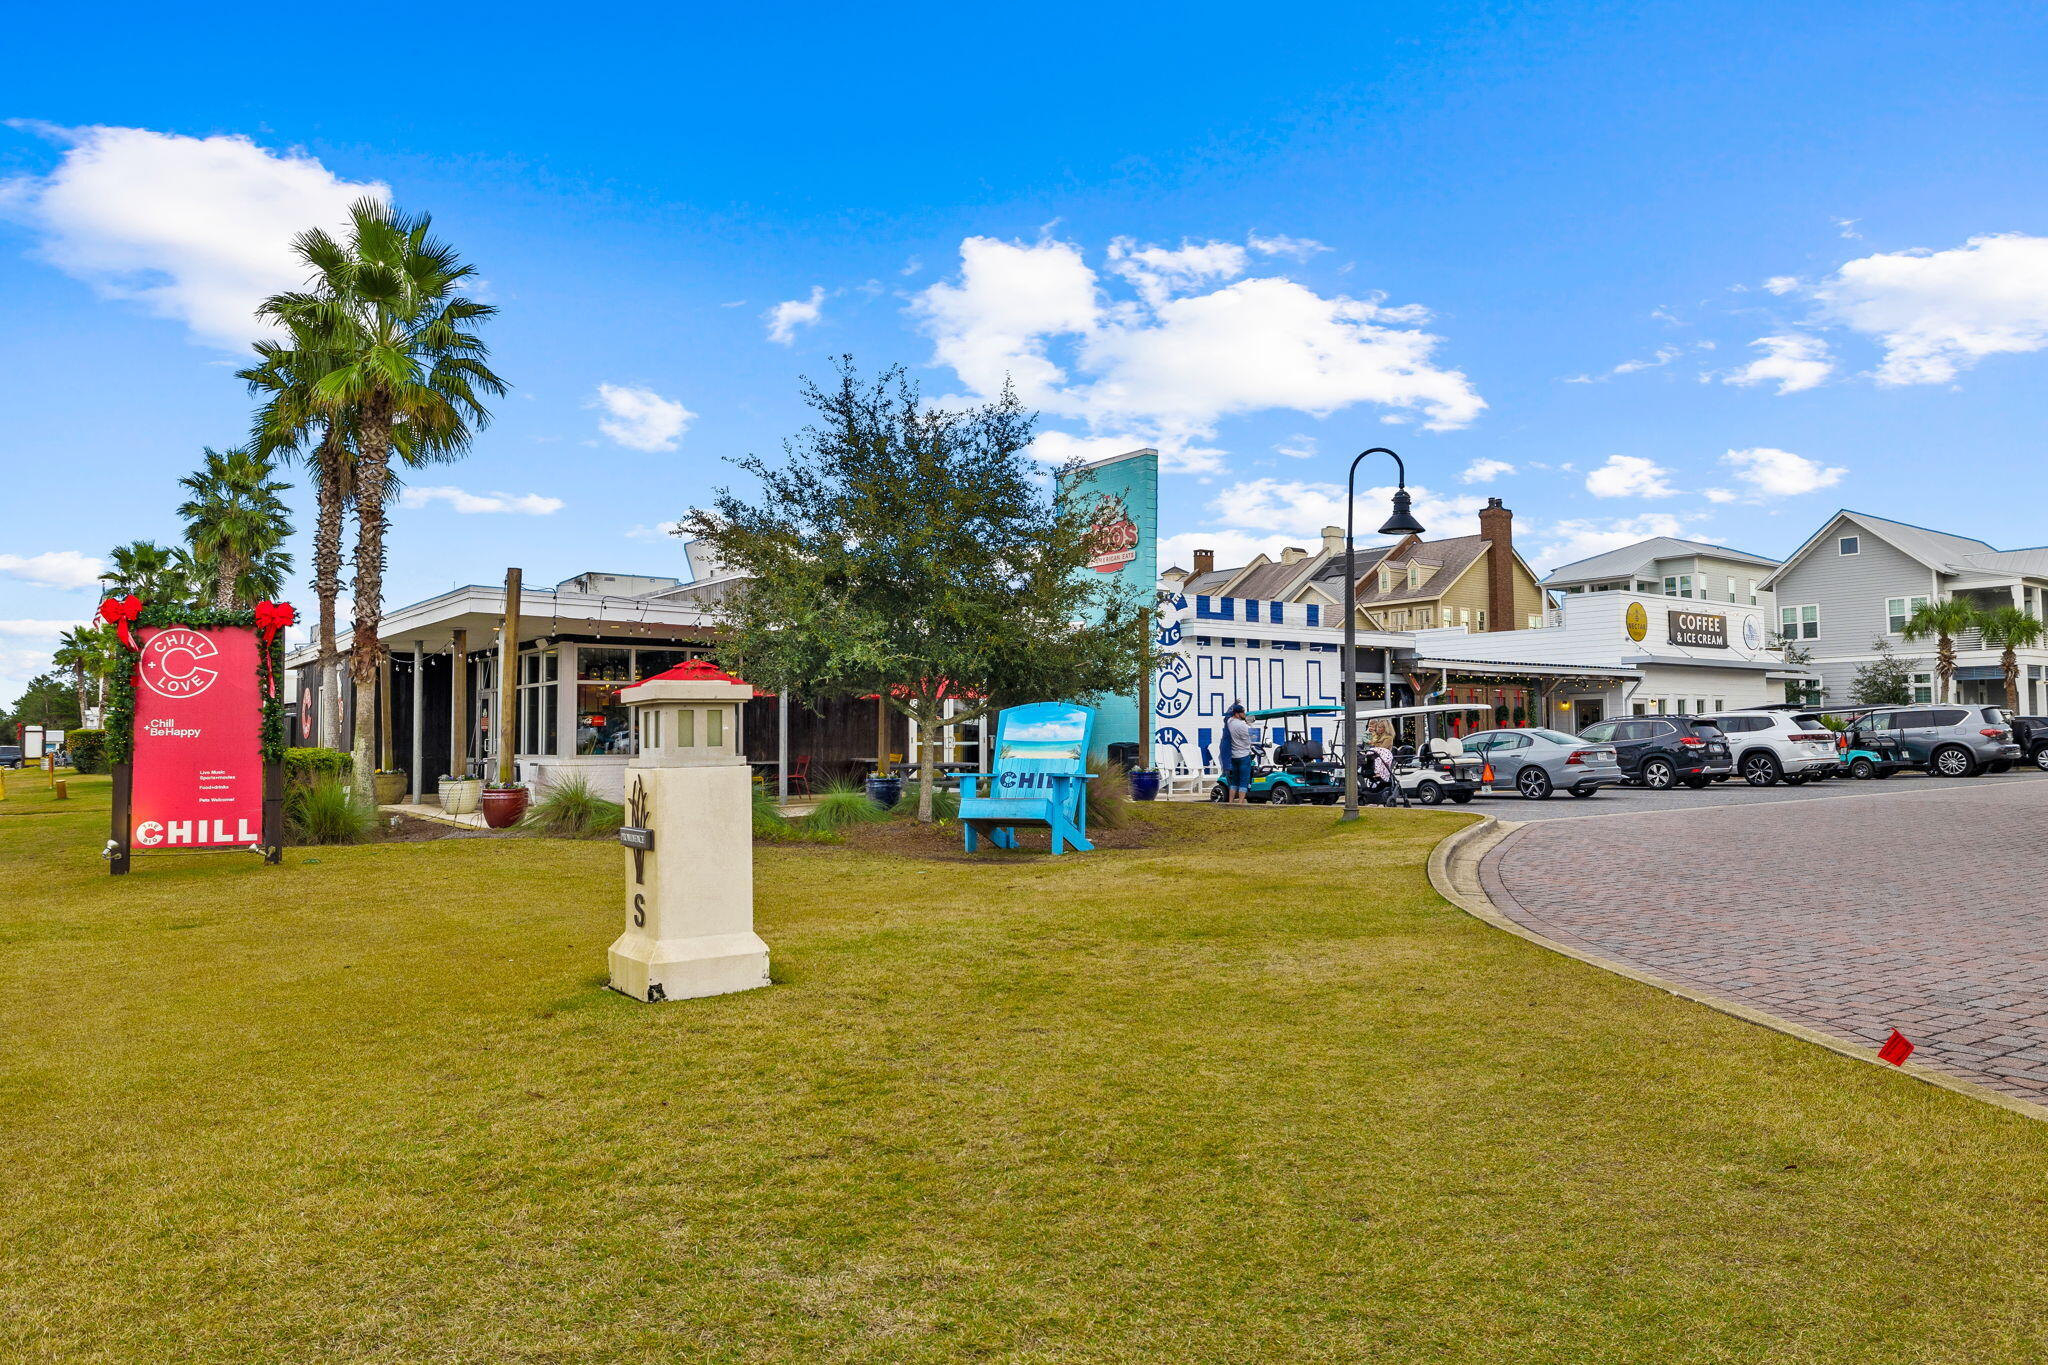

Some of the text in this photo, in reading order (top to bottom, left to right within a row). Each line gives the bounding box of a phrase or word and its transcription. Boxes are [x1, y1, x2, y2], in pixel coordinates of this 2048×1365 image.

[1679, 614, 1720, 632] COFFEE
[154, 634, 206, 654] CHILL
[1676, 632, 1723, 645] & ICE CREAM
[157, 675, 205, 692] LOVE
[1156, 698, 1182, 713] BIG
[150, 718, 175, 728] Chill
[634, 893, 646, 928] S
